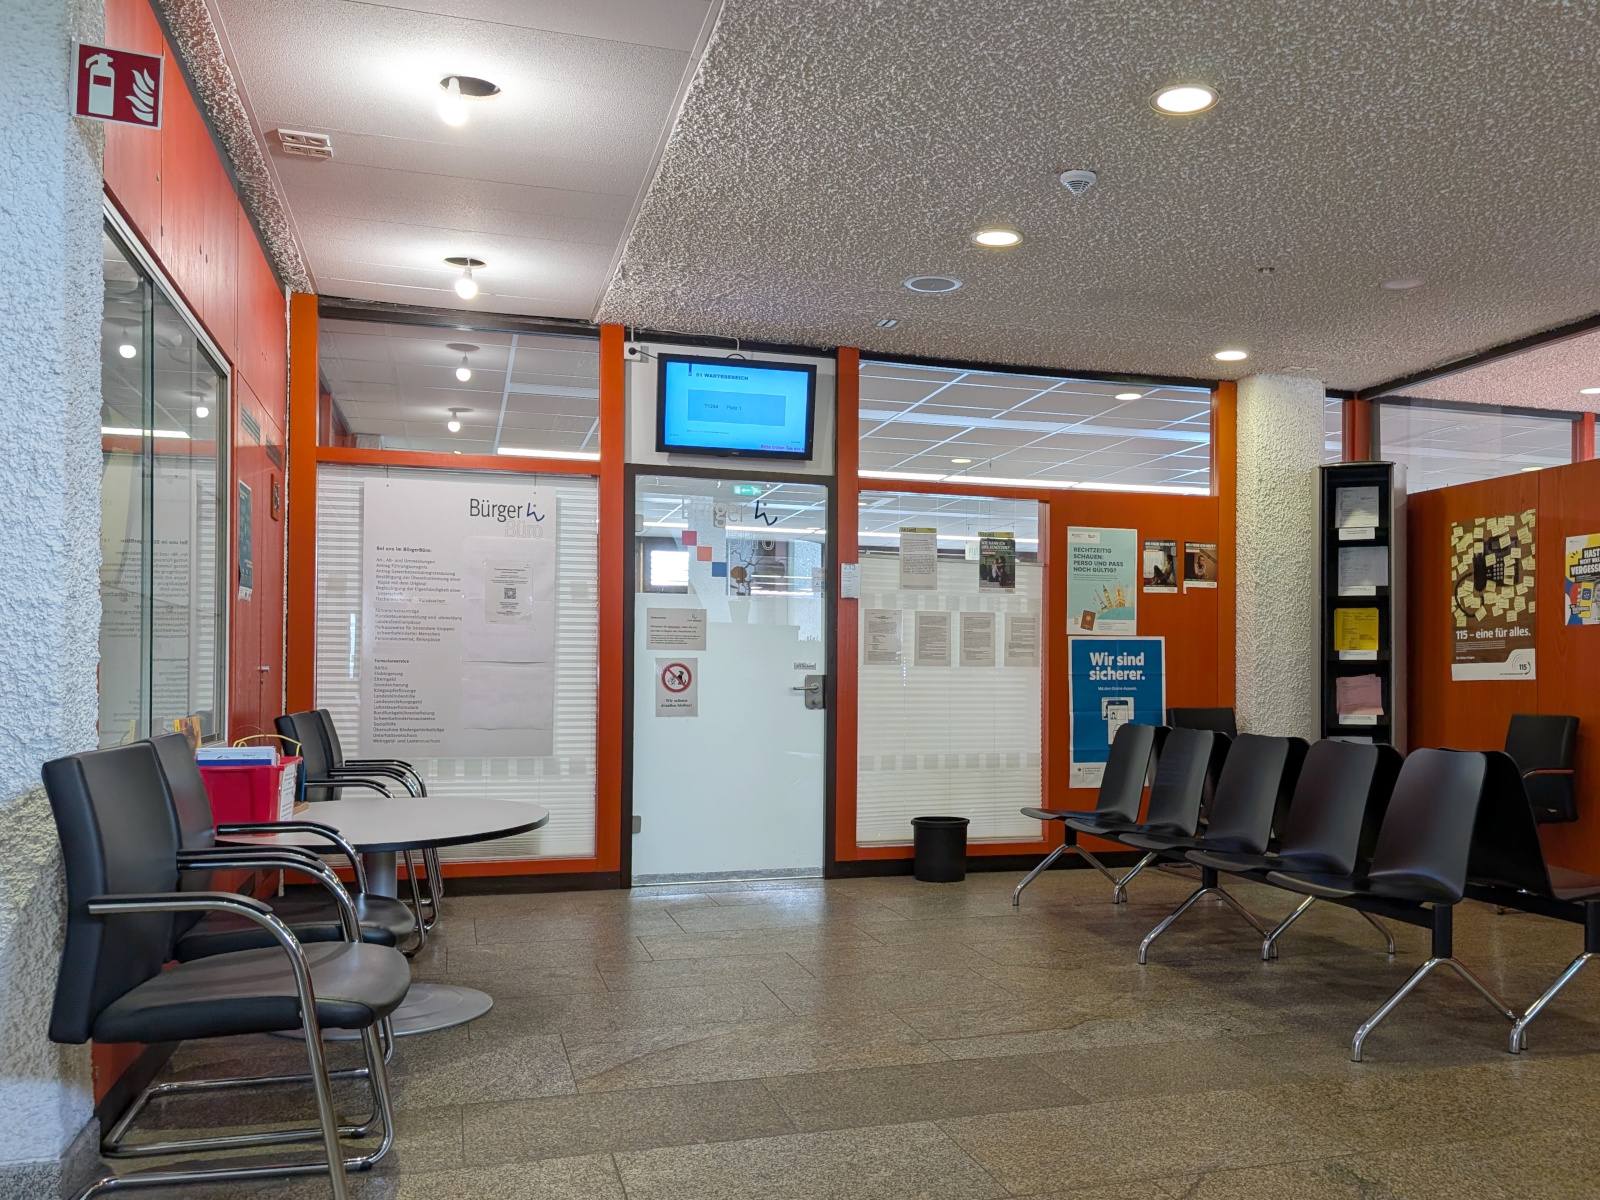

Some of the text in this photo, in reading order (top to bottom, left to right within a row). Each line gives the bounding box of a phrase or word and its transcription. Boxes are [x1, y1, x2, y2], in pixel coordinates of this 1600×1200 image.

[470, 498, 523, 522] Bürger
[505, 520, 543, 539] Büro
[1584, 548, 1600, 558] HAST
[1456, 630, 1468, 640] 115
[1476, 629, 1493, 638] eine
[1495, 627, 1508, 637] für
[1509, 626, 1531, 637] alles.
[1089, 652, 1144, 666] Wir sind
[1089, 666, 1145, 680] sicherer.
